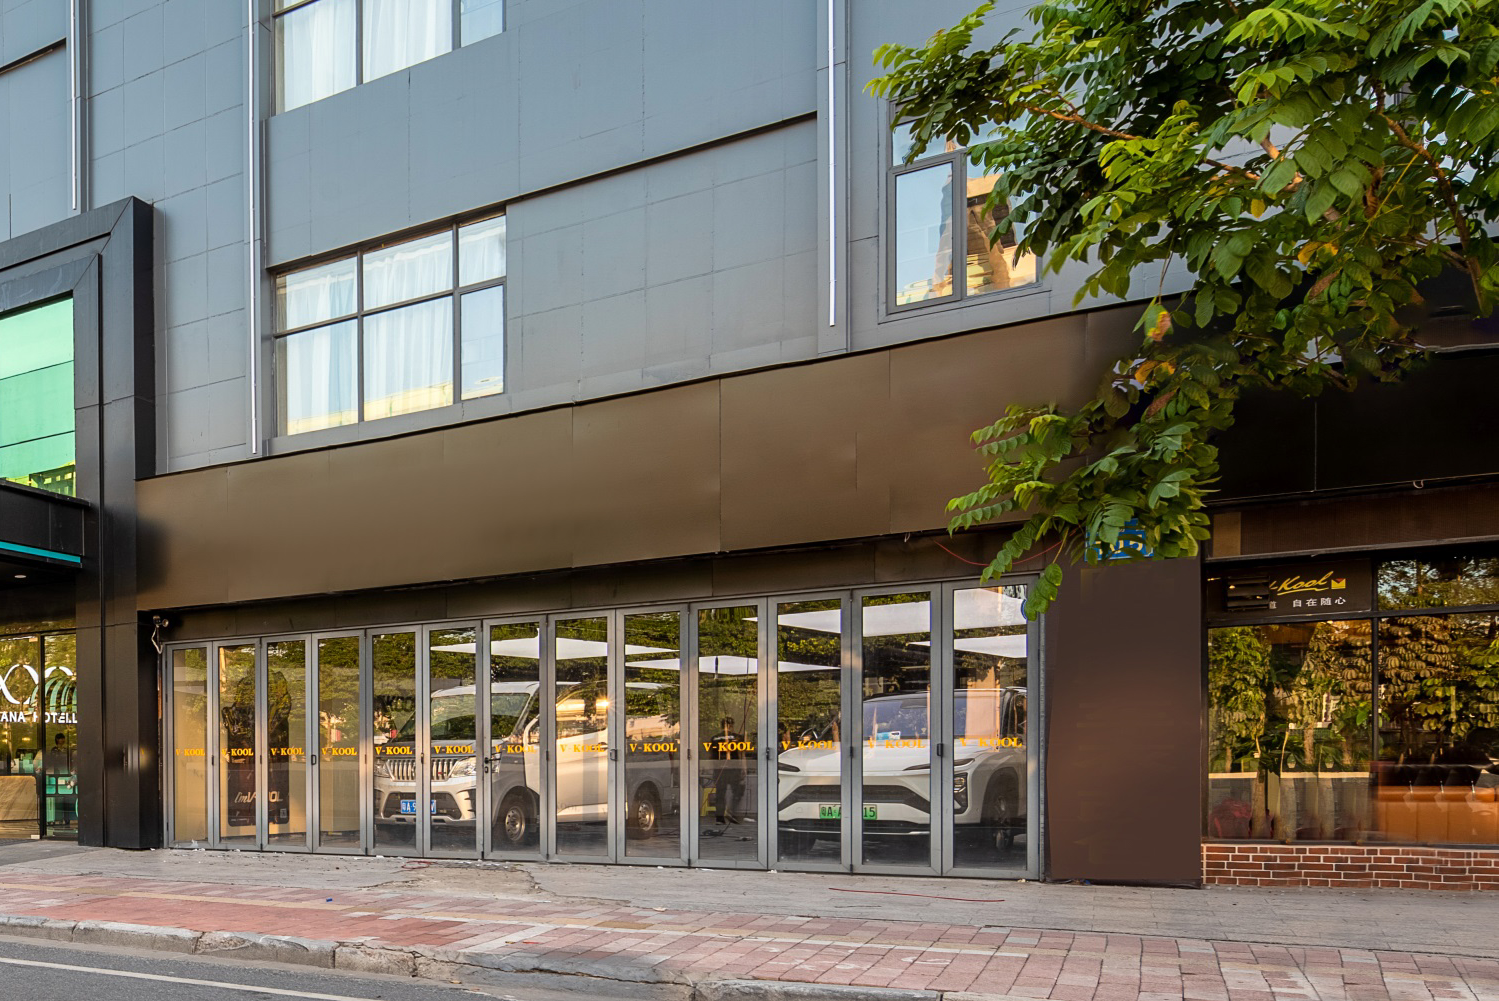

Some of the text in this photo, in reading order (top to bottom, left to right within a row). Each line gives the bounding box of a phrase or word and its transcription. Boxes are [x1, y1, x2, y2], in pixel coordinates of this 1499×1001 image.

[1292, 596, 1347, 608] 自在随心
[375, 746, 413, 755] V-KOOL
[433, 745, 474, 754] V-KOOL
[629, 742, 677, 752] V-KOOL
[703, 741, 755, 752] V-KOOL
[270, 747, 305, 756] V-KOOL
[321, 747, 358, 756] V-KOOL
